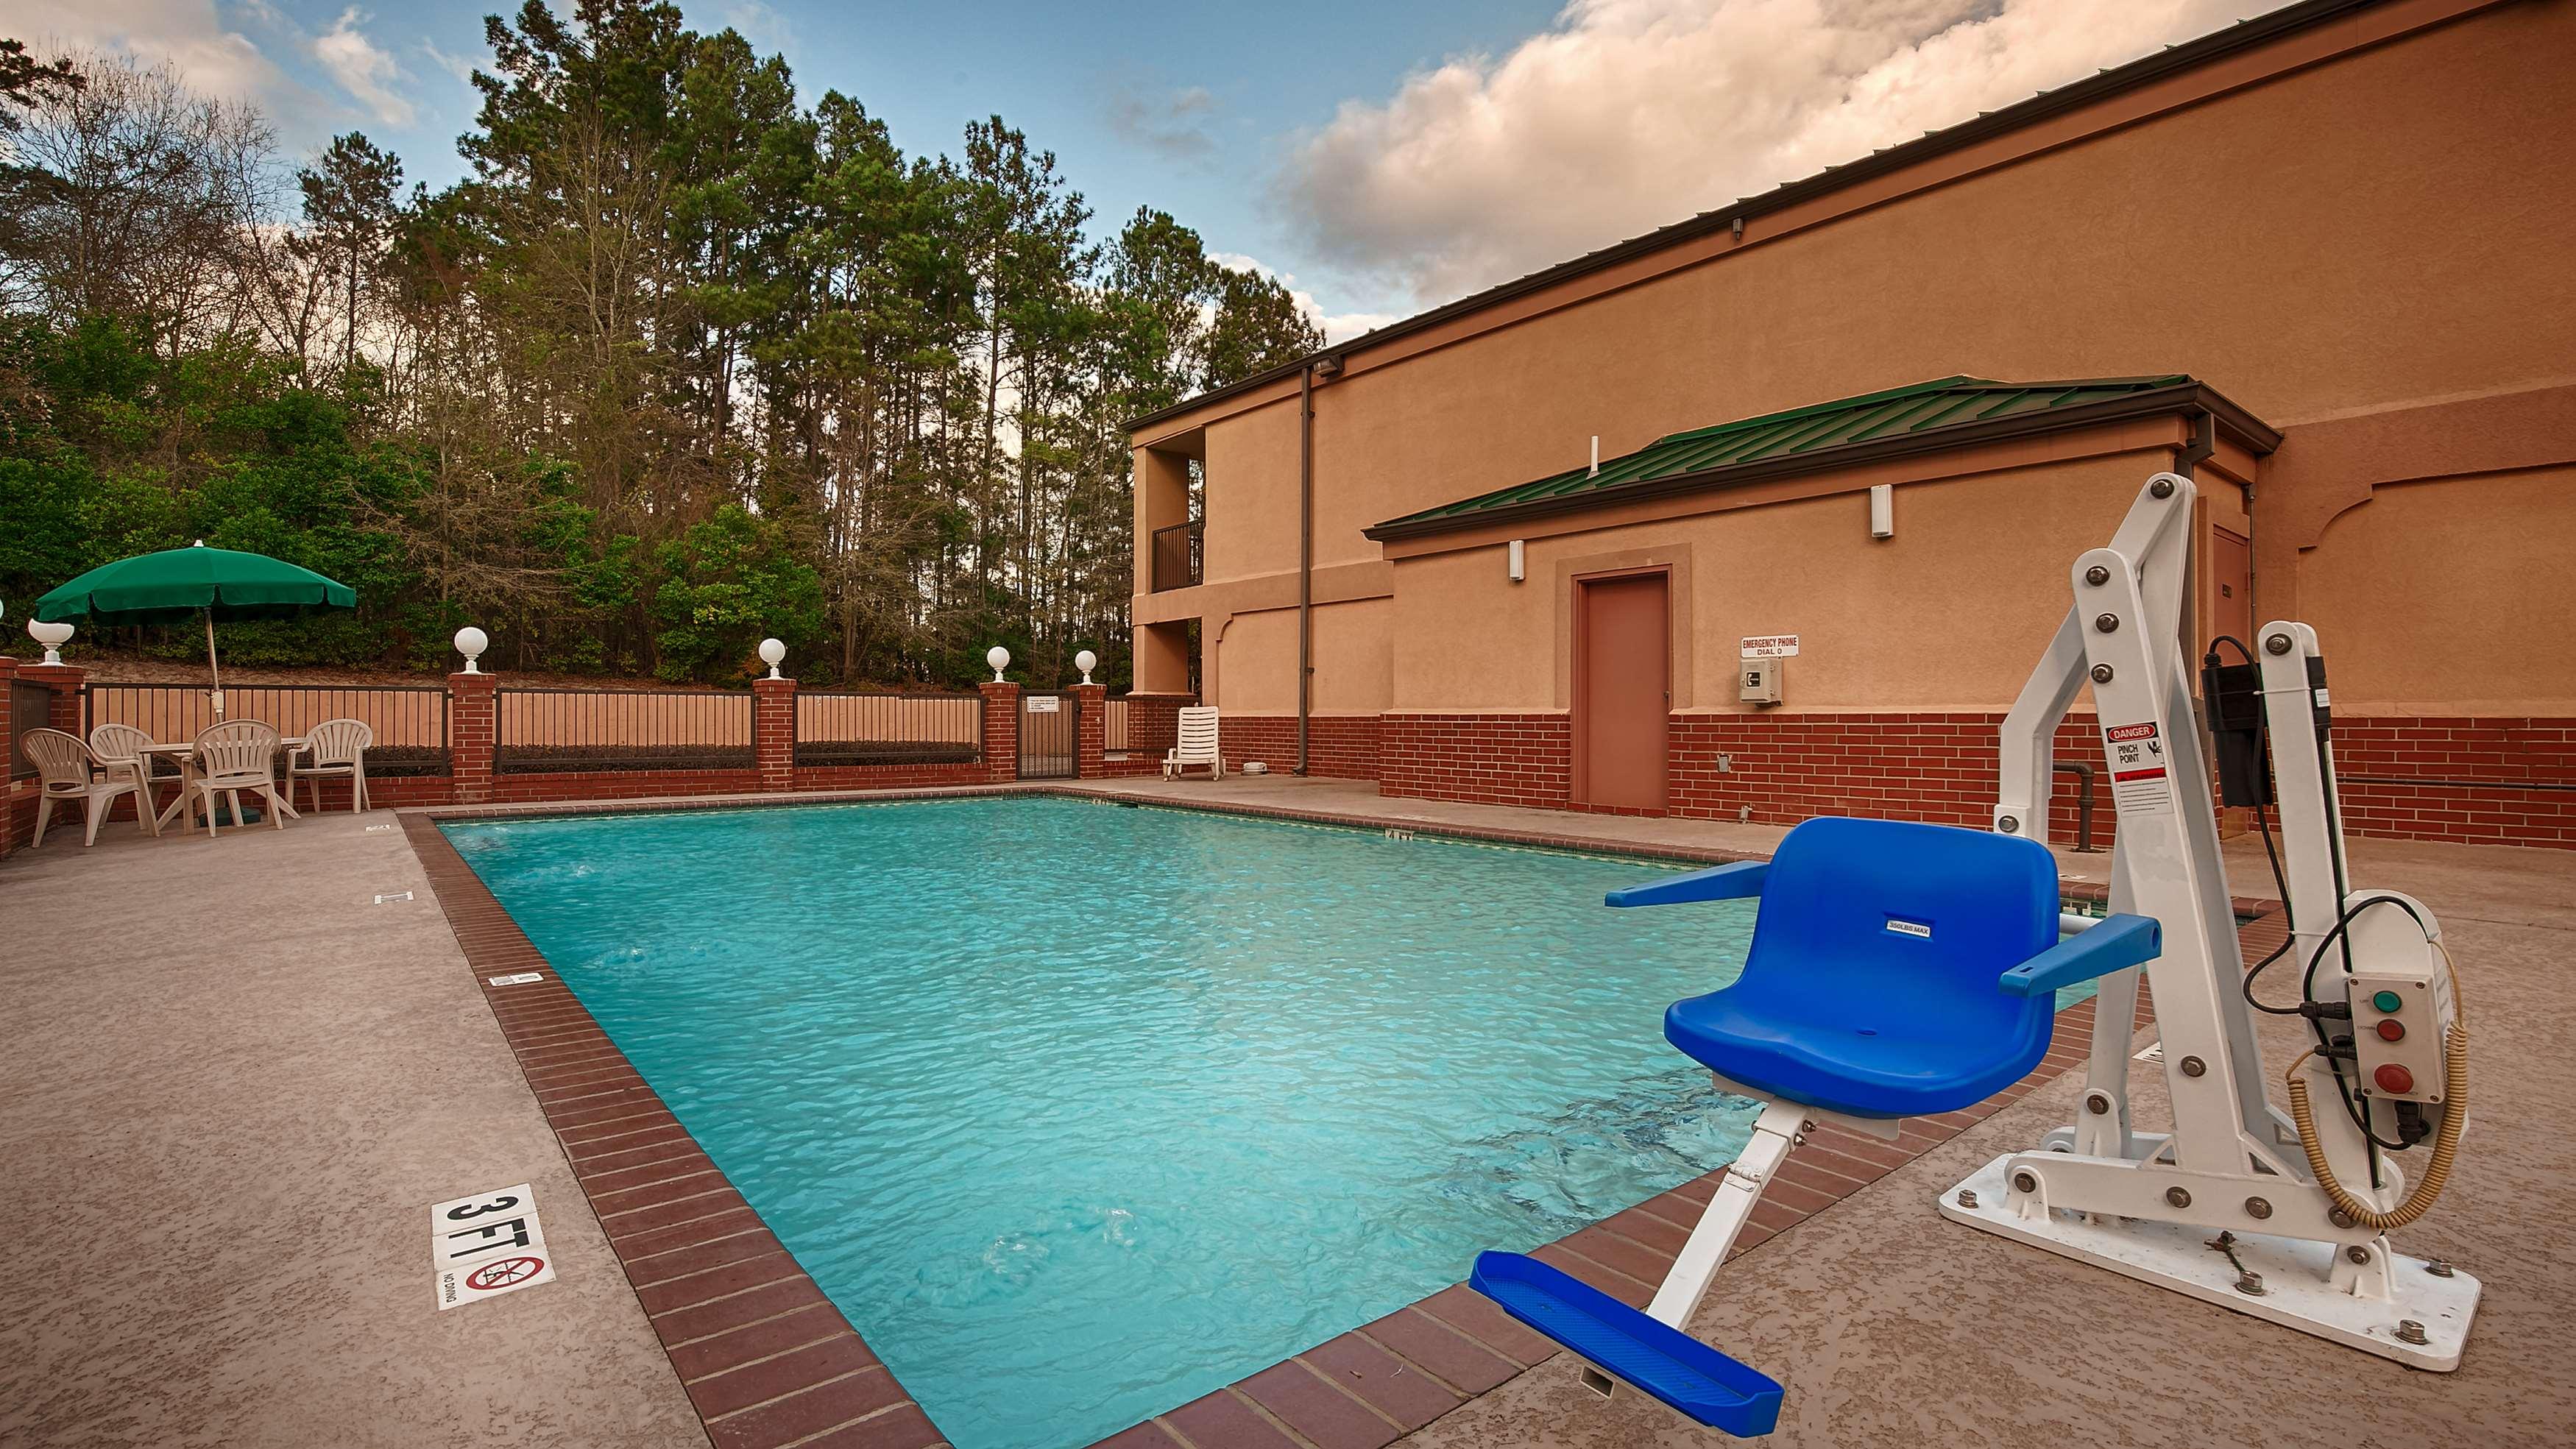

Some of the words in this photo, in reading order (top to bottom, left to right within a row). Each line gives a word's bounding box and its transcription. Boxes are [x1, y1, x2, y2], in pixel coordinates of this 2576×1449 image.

[1743, 638, 1776, 648] EMERGENCY
[1778, 637, 1797, 647] PHONE
[2114, 726, 2150, 739] DANGER
[2117, 744, 2138, 754] PINCH
[2120, 754, 2139, 764] POINT
[1914, 927, 1928, 935] MAX
[447, 1196, 519, 1219] 3
[448, 1218, 530, 1258] FT
[443, 1272, 454, 1283] NO
[445, 1283, 456, 1303] DIVING
